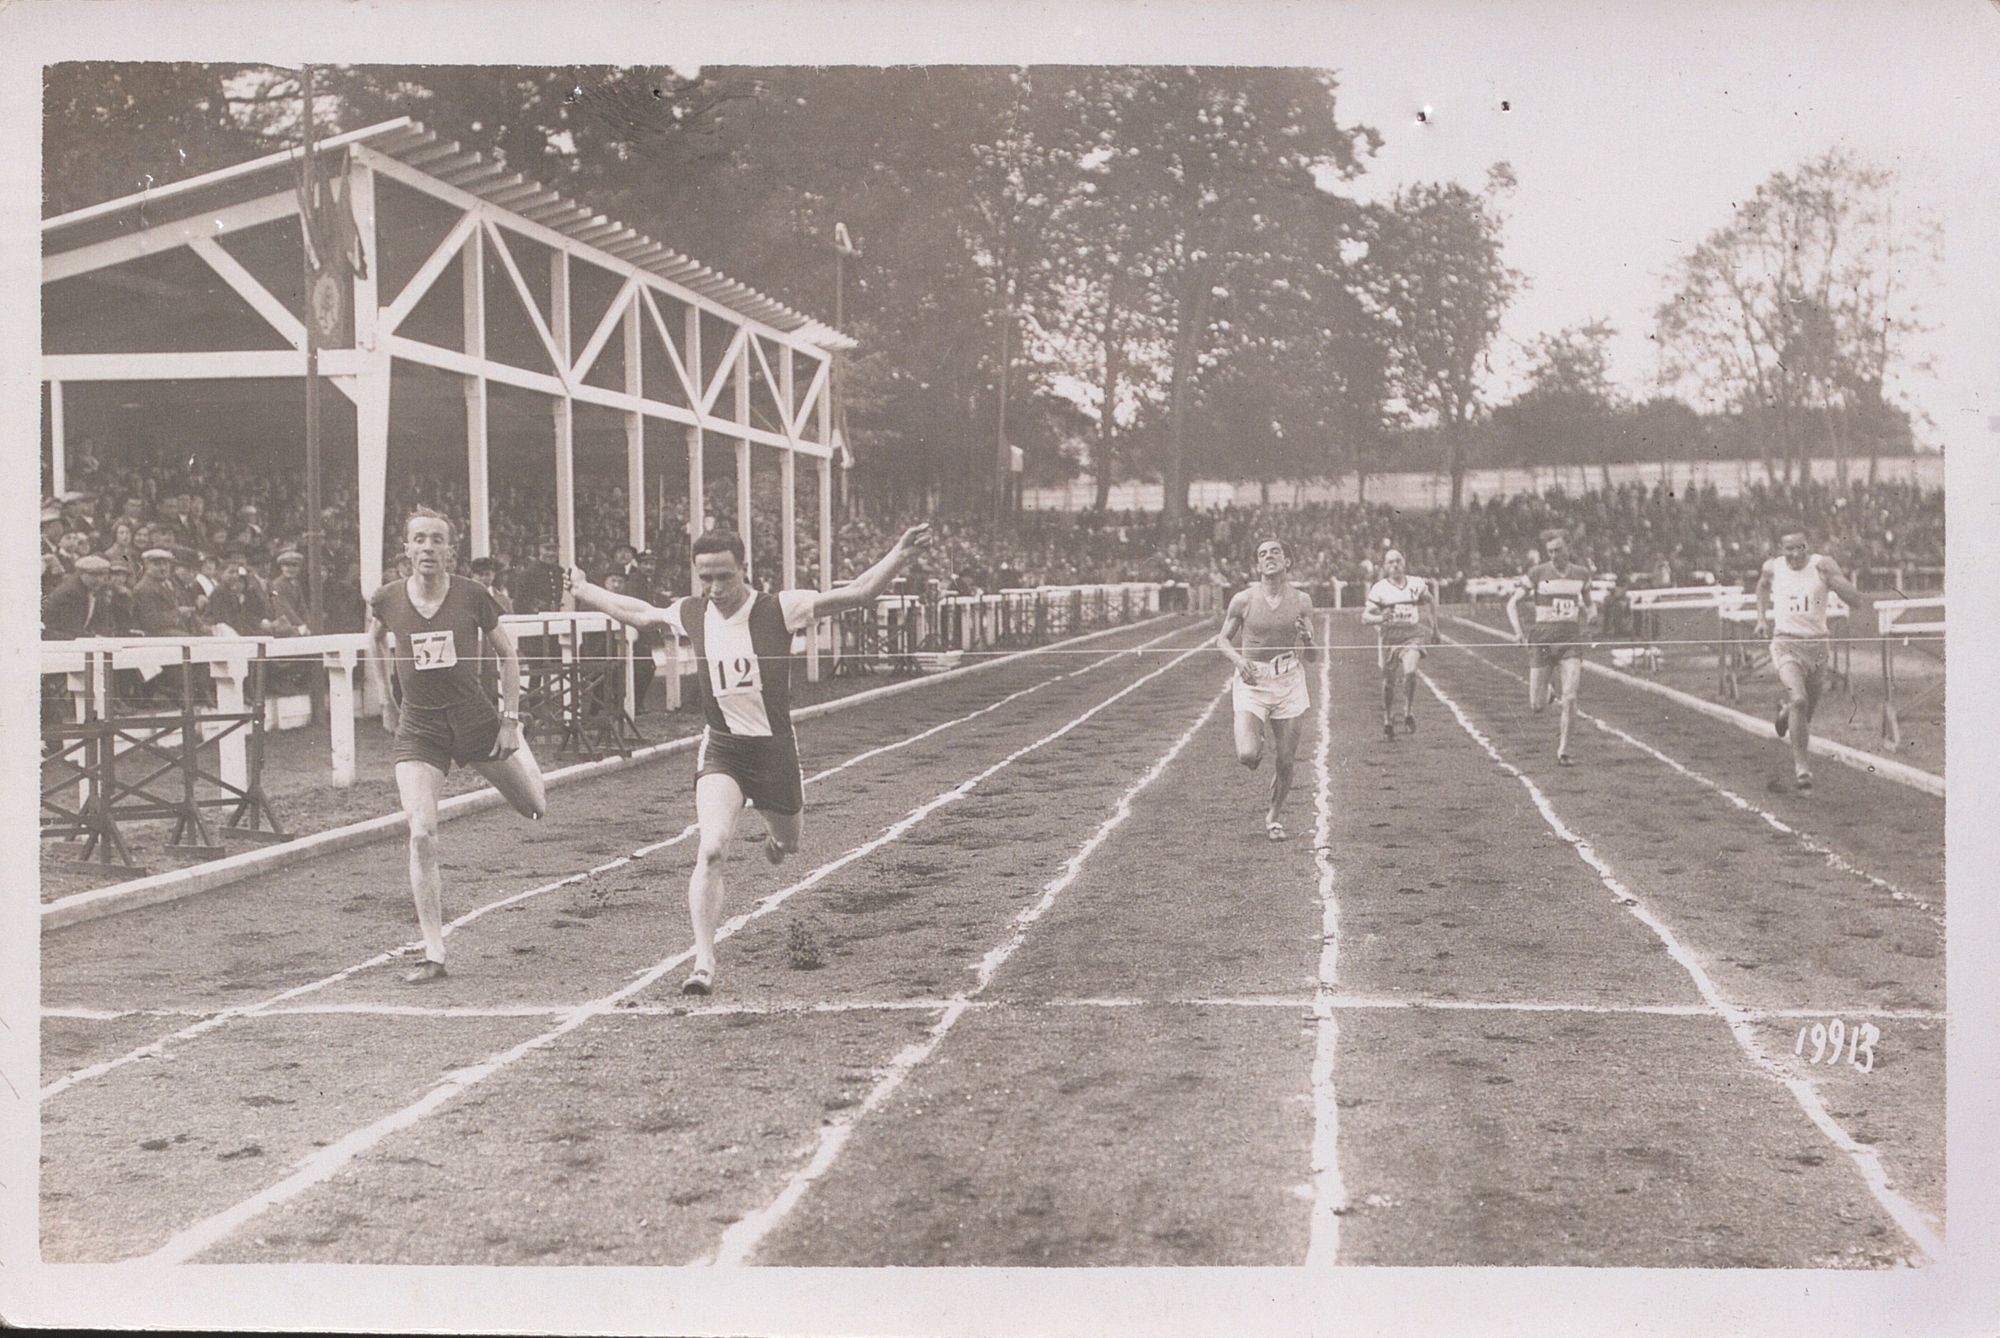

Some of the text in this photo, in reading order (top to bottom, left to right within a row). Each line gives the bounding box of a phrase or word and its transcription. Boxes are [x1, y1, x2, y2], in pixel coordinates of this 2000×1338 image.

[413, 636, 447, 666] 37
[1274, 654, 1293, 676] 17
[718, 657, 753, 690] 12
